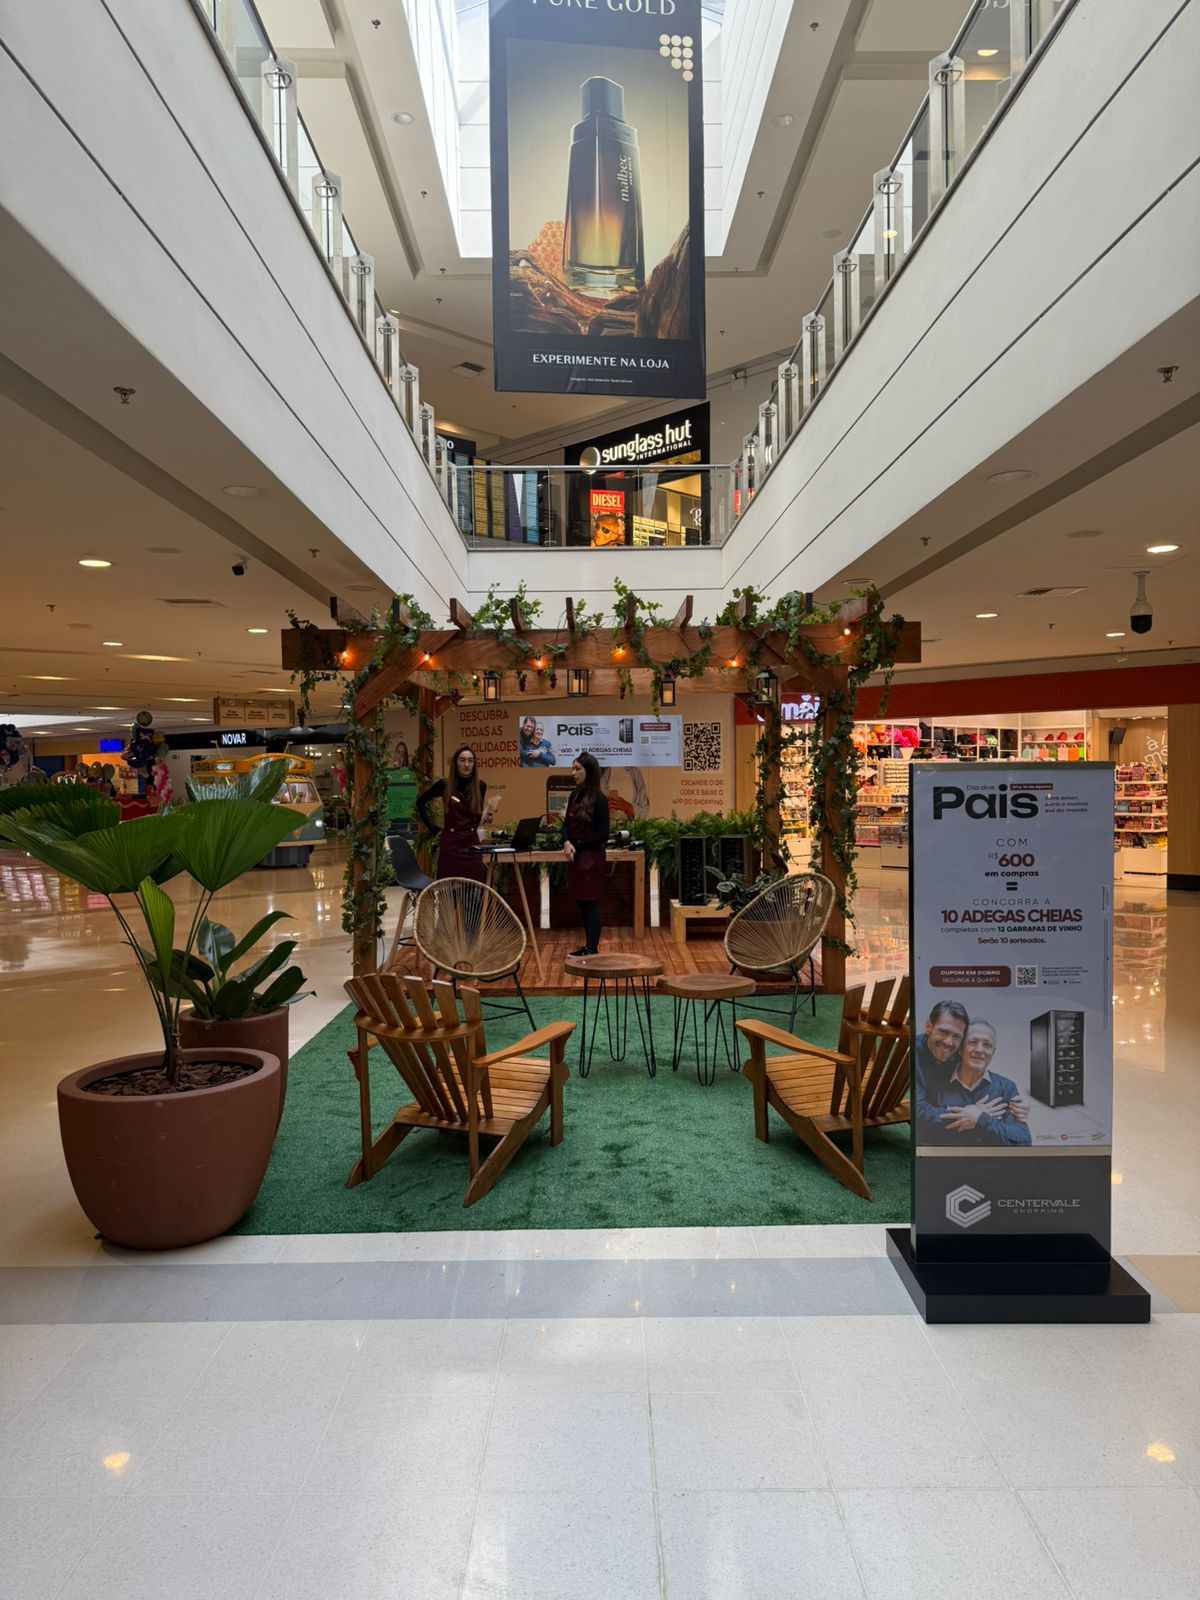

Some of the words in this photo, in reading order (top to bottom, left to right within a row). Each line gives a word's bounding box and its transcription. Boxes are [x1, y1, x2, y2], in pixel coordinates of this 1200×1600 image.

[532, 354, 617, 367] EXPERIMENTE
[620, 358, 637, 368] NA
[640, 358, 670, 369] LOJA
[602, 433, 664, 464] sunglass
[665, 419, 693, 445] hut
[636, 440, 692, 460] INTERNATIONAL
[592, 493, 622, 507] DIESEL
[459, 710, 510, 722] DESCUBRA
[460, 726, 490, 737] TODAS
[491, 725, 504, 736] AS
[556, 723, 594, 736] Pais
[222, 732, 247, 745] NOVAR
[933, 783, 1040, 820] Pais
[996, 838, 1029, 848] COM
[998, 853, 1035, 868] 600
[1001, 870, 1039, 879] compras
[972, 897, 1039, 906] CONCORRA
[941, 909, 959, 923] 10
[961, 909, 1025, 923] ADEGAS
[1028, 908, 1083, 922] CHEIAS
[998, 1199, 1081, 1208] CENTERVALE
